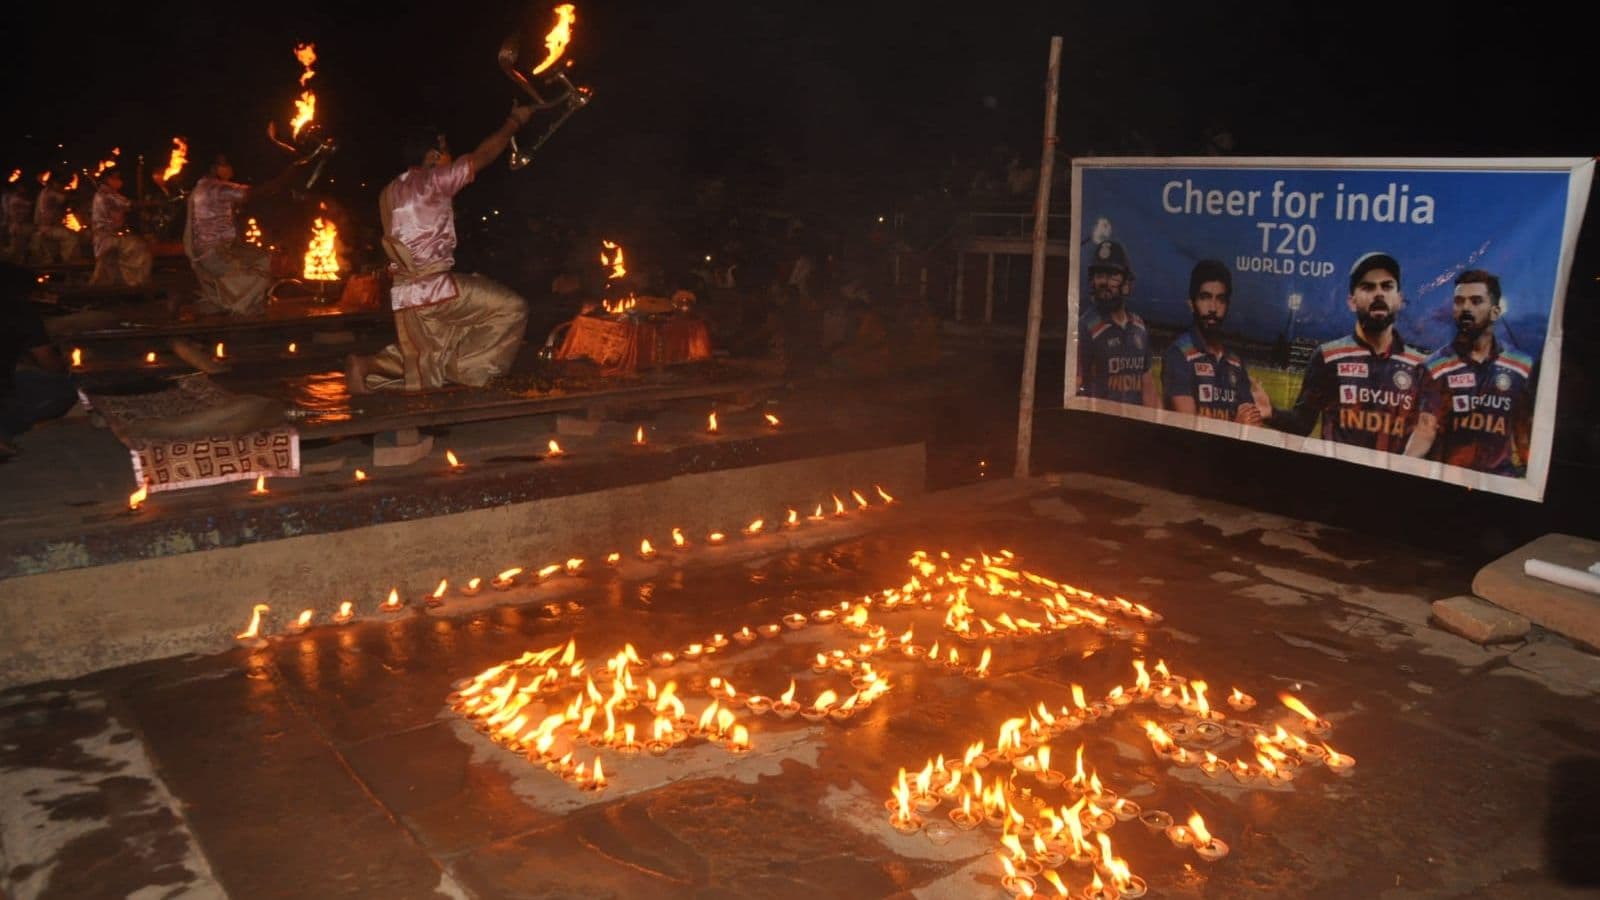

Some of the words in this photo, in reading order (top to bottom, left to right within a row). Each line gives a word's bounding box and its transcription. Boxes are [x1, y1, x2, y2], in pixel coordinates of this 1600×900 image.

[1162, 179, 1261, 217] Cheer
[1272, 180, 1324, 220] for
[1335, 183, 1435, 225] india
[1256, 221, 1317, 256] T20
[1236, 256, 1295, 274] WORLD
[1299, 260, 1335, 278] CUP
[1359, 388, 1413, 410] BYJU'S
[1340, 408, 1407, 437] INDIA
